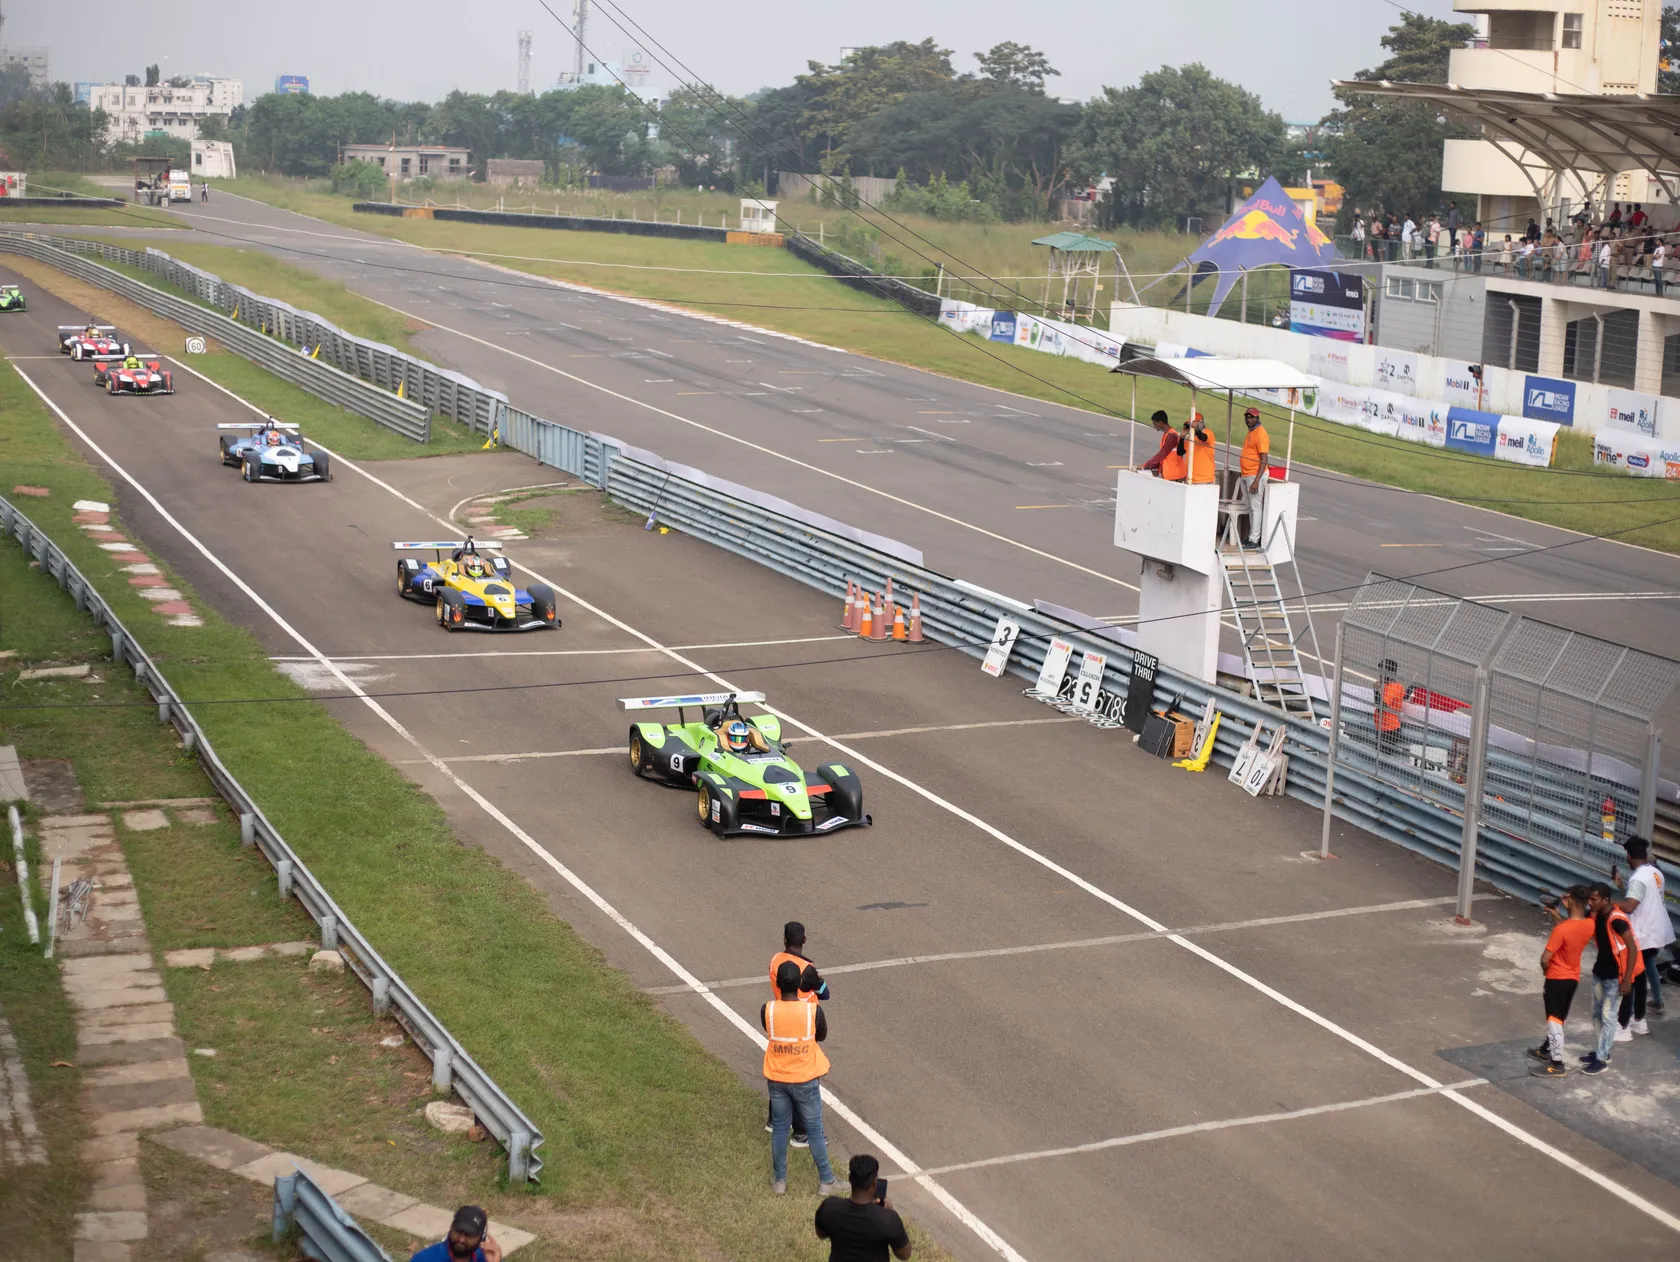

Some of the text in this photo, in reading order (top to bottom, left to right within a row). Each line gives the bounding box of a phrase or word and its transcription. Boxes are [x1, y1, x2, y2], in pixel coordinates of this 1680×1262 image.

[1260, 200, 1286, 217] Bull
[191, 342, 201, 351] 60
[1389, 365, 1395, 377] 2
[1446, 378, 1463, 389] Mobil
[1373, 403, 1379, 417] 2
[1402, 413, 1419, 426] Mobil
[1618, 412, 1635, 423] meil
[1507, 437, 1524, 448] meil
[1597, 444, 1612, 453] news
[1526, 445, 1545, 456] Apollo
[425, 580, 431, 590] 6
[999, 626, 1012, 647] 3
[1134, 651, 1157, 670] DRIVE
[1080, 670, 1101, 682] MINUTES
[1134, 664, 1154, 682] THRU
[1080, 681, 1092, 704] 5
[673, 756, 680, 769] 9
[1236, 761, 1245, 777] 7
[1250, 770, 1264, 788] 10
[785, 785, 797, 794] 9
[772, 1043, 809, 1055] MMSC
